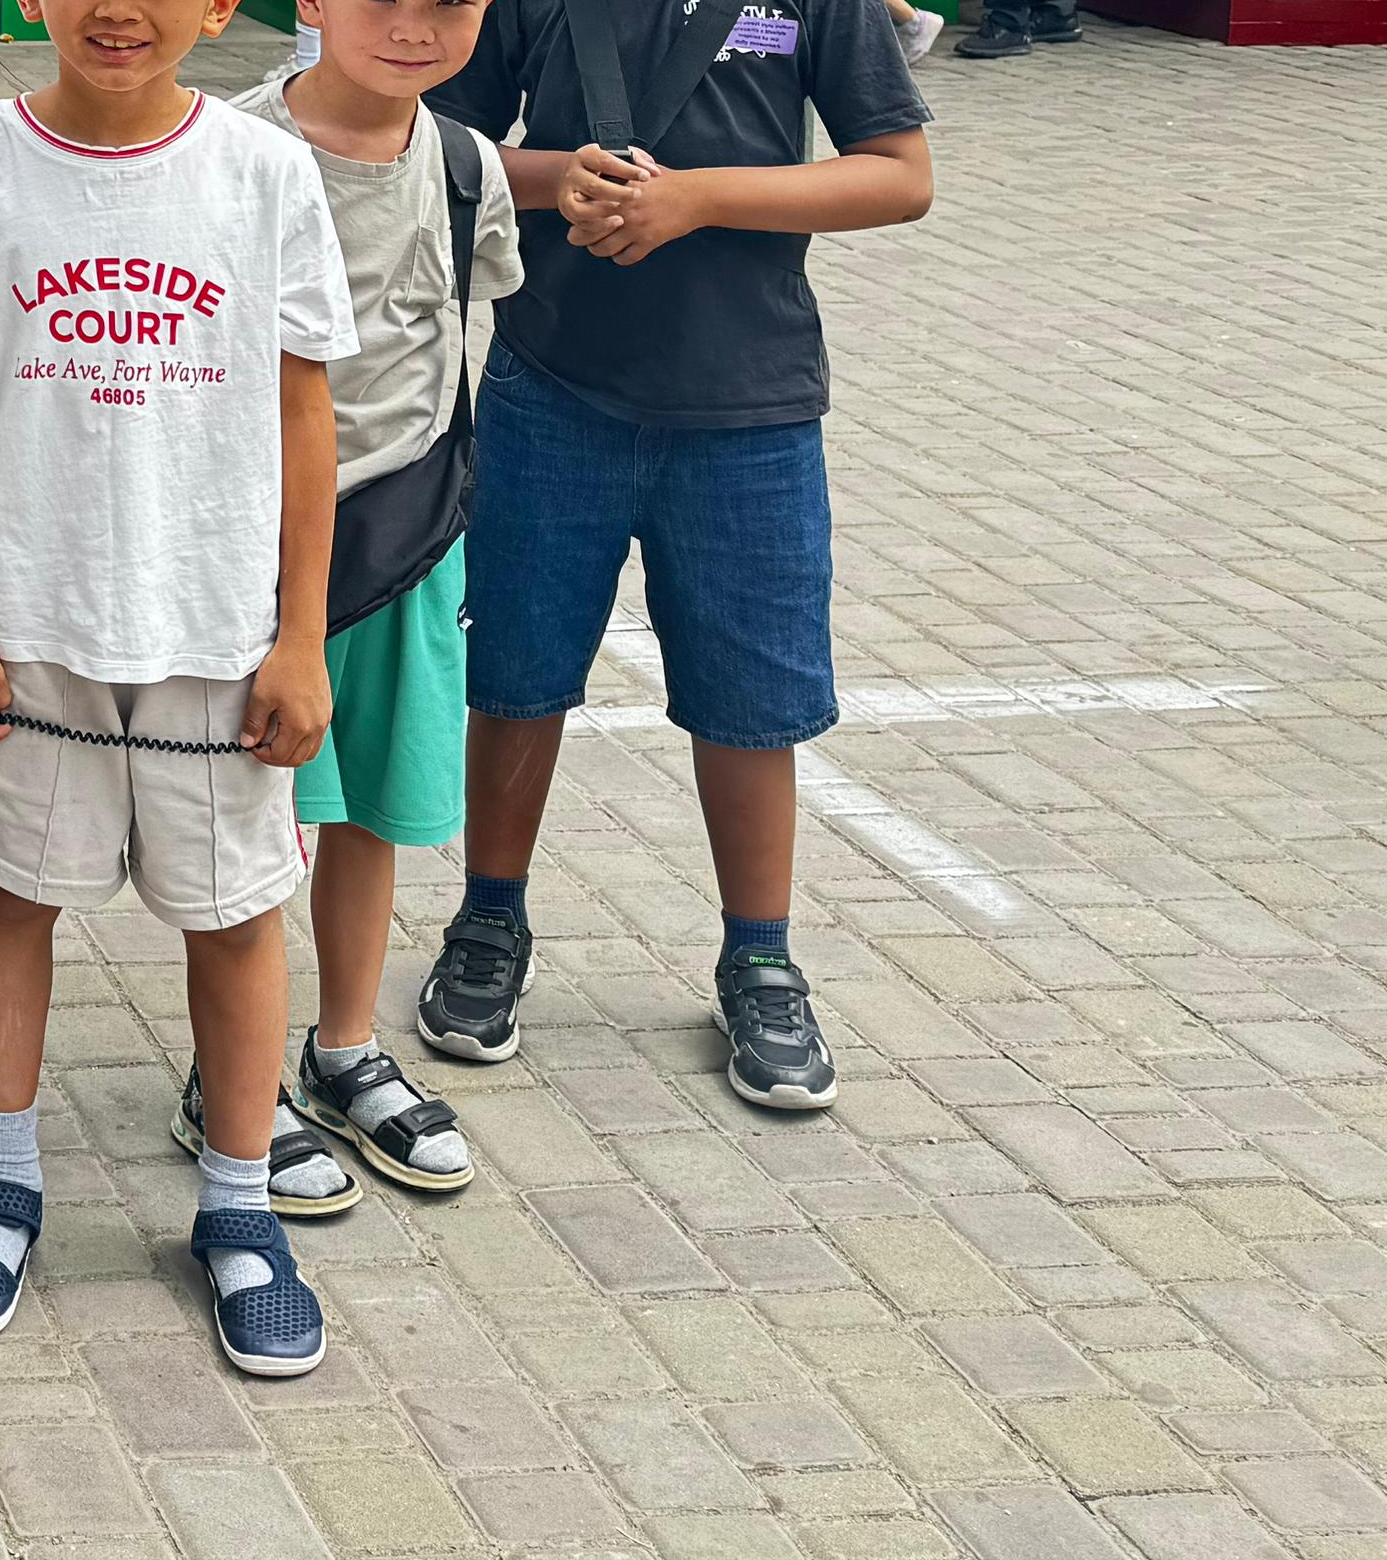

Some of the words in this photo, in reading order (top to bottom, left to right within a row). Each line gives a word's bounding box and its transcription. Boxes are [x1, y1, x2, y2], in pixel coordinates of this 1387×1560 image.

[12, 258, 225, 318] LAKESIDE
[49, 309, 184, 345] COURT
[14, 357, 56, 379] Lake
[61, 358, 105, 384] Ave,
[113, 359, 152, 382] Fort
[160, 361, 225, 388] Wayne
[90, 388, 145, 405] 46805
